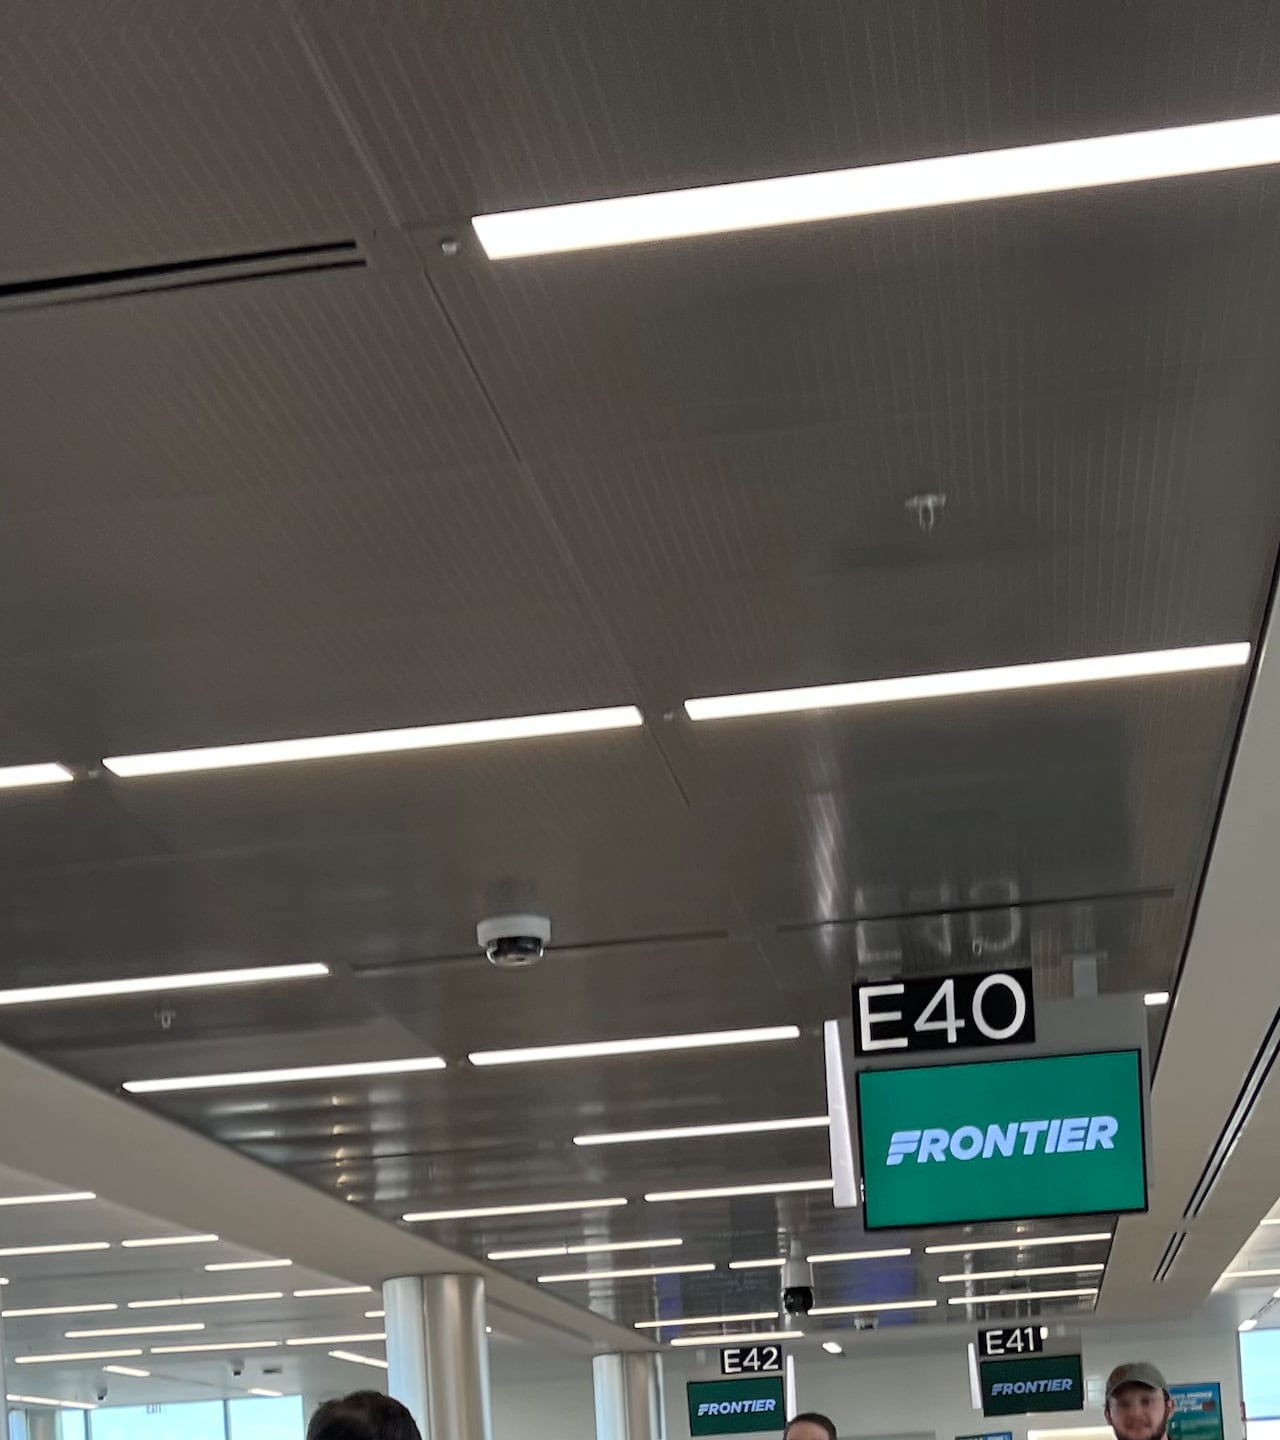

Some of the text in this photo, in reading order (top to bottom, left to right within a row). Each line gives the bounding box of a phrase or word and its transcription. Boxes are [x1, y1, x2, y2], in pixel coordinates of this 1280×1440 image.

[858, 973, 1026, 1051] E40
[886, 1115, 1119, 1166] FRONTIER
[985, 1327, 1034, 1355] E41
[723, 1346, 780, 1374] E42
[991, 1378, 1073, 1396] FRONTIER
[697, 1398, 776, 1417] FRONTIER
